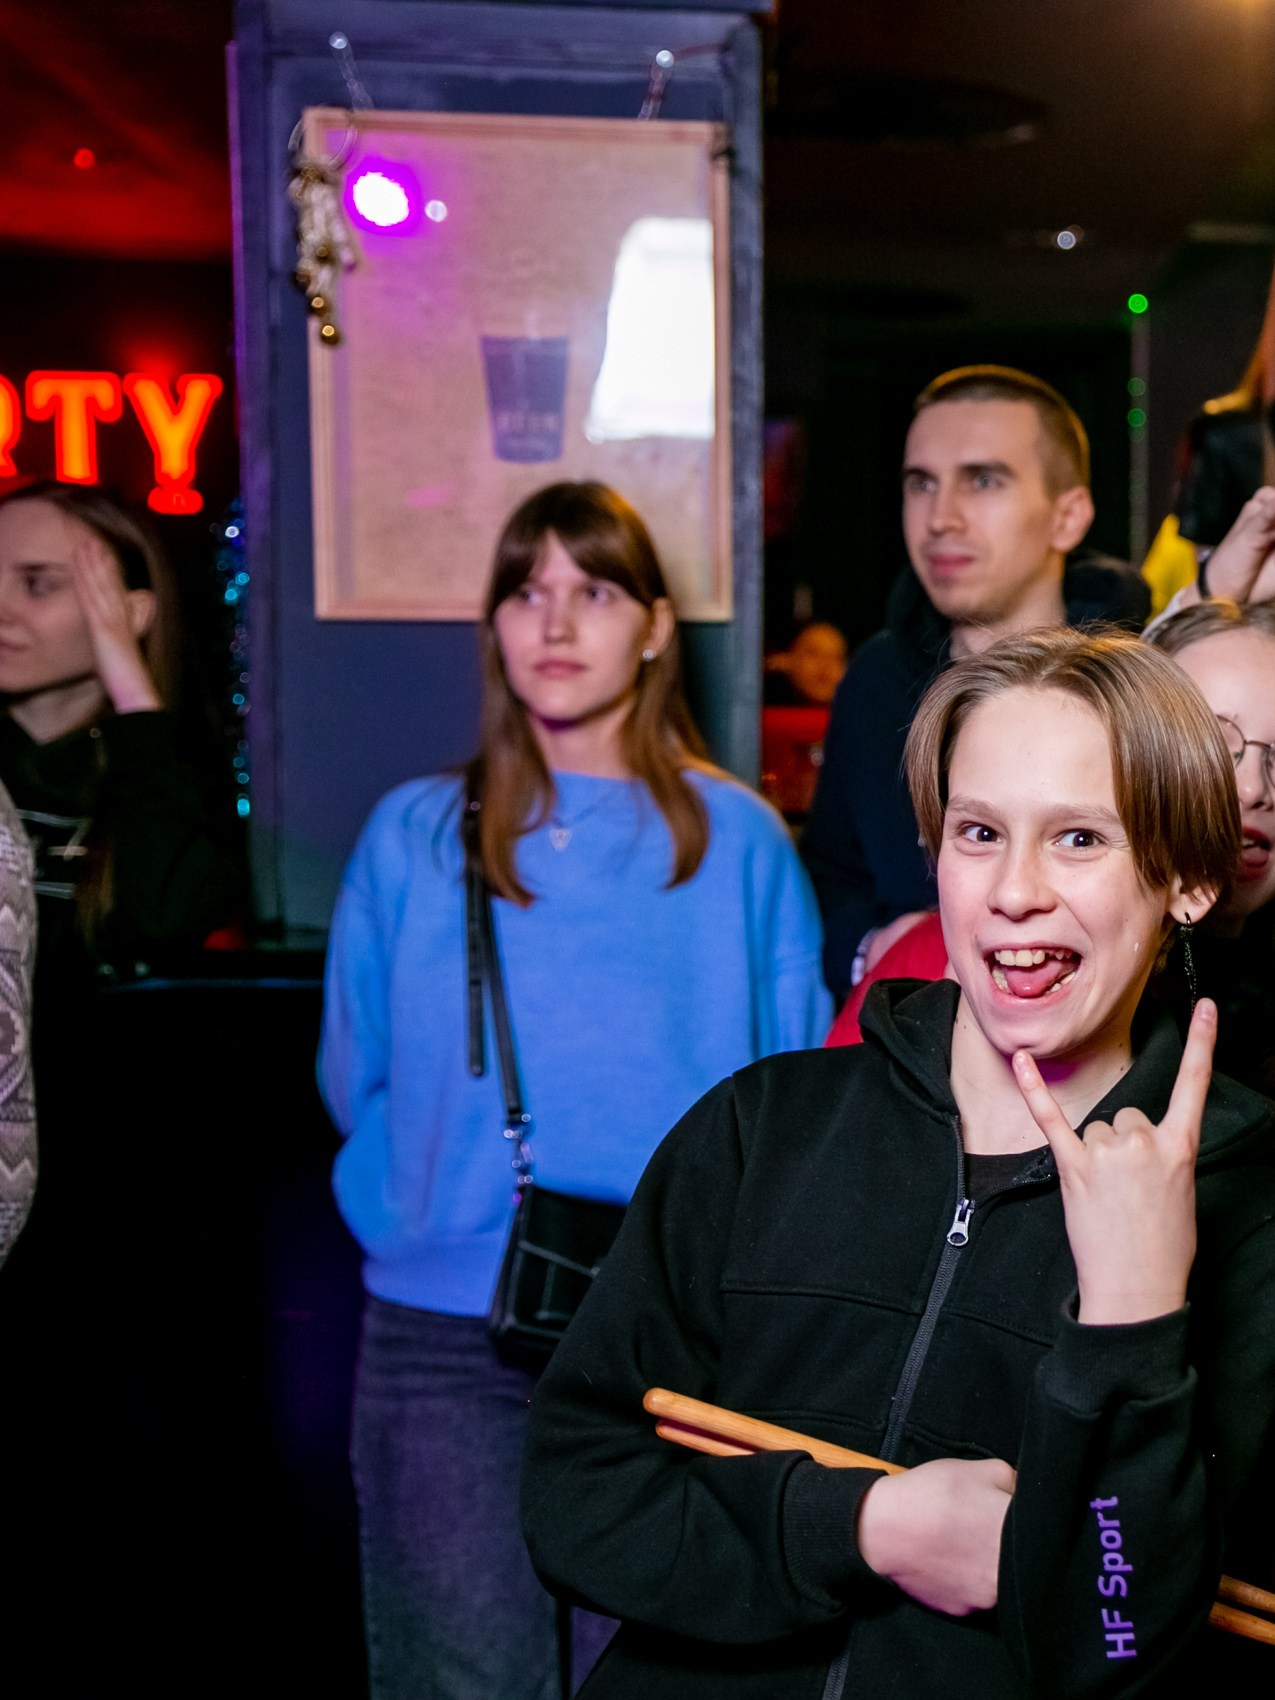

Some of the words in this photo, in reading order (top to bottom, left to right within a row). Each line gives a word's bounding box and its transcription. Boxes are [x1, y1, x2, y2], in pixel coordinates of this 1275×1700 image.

[0, 370, 224, 515] TY
[1089, 1496, 1133, 1598] Sport
[1101, 1608, 1137, 1659] HF
